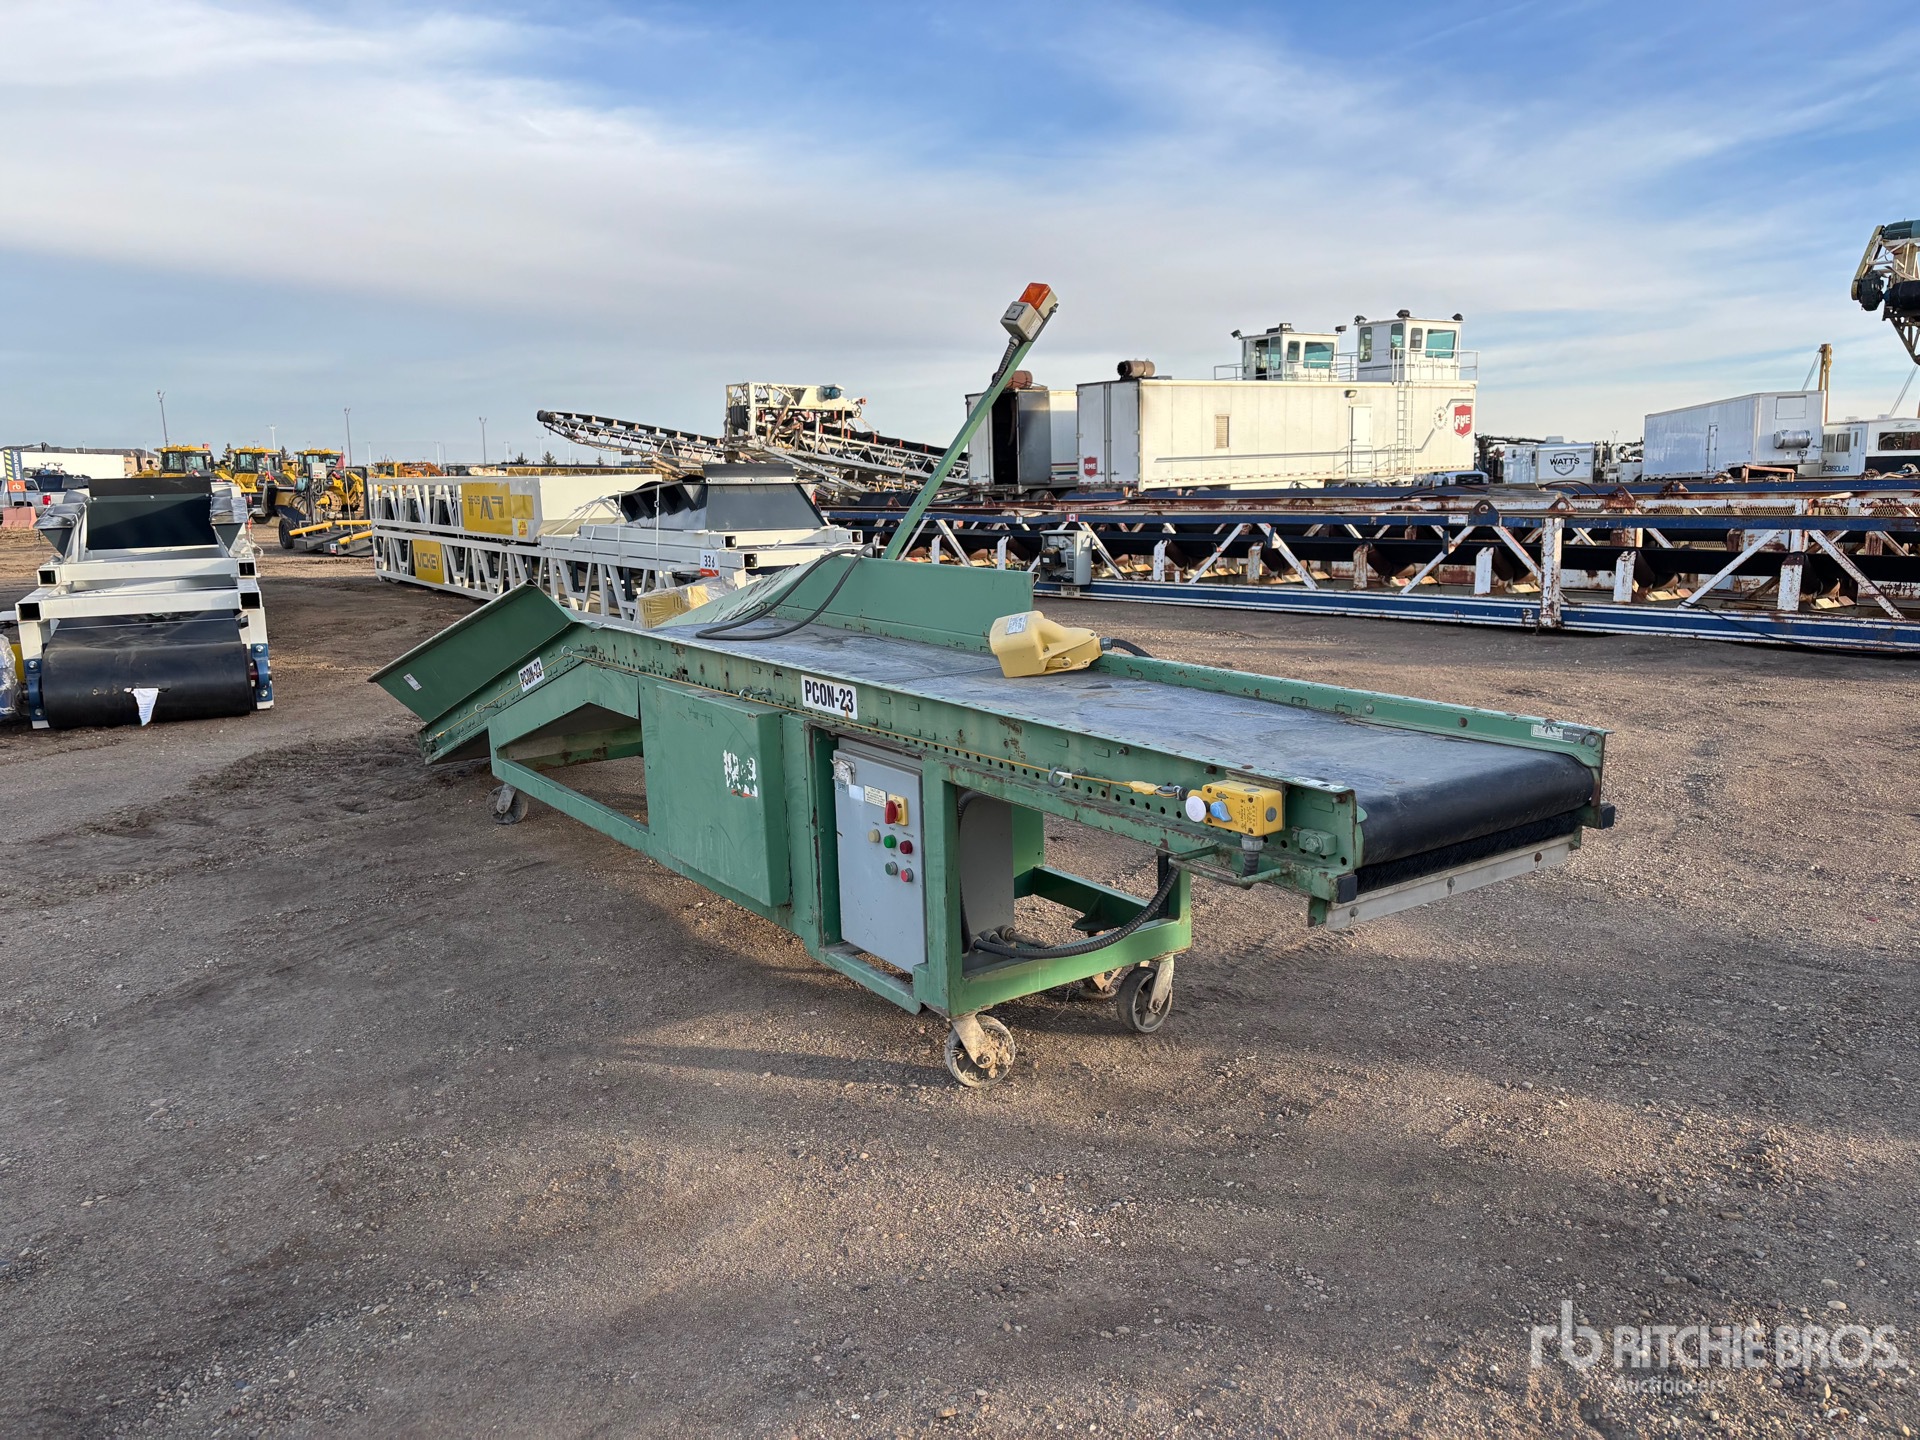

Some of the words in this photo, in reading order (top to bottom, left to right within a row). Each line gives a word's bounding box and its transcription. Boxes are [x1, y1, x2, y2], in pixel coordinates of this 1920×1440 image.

[1085, 463, 1096, 471] RME
[1550, 457, 1579, 466] WATTS
[519, 660, 543, 688] PCON-23
[804, 679, 854, 713] PCON-23
